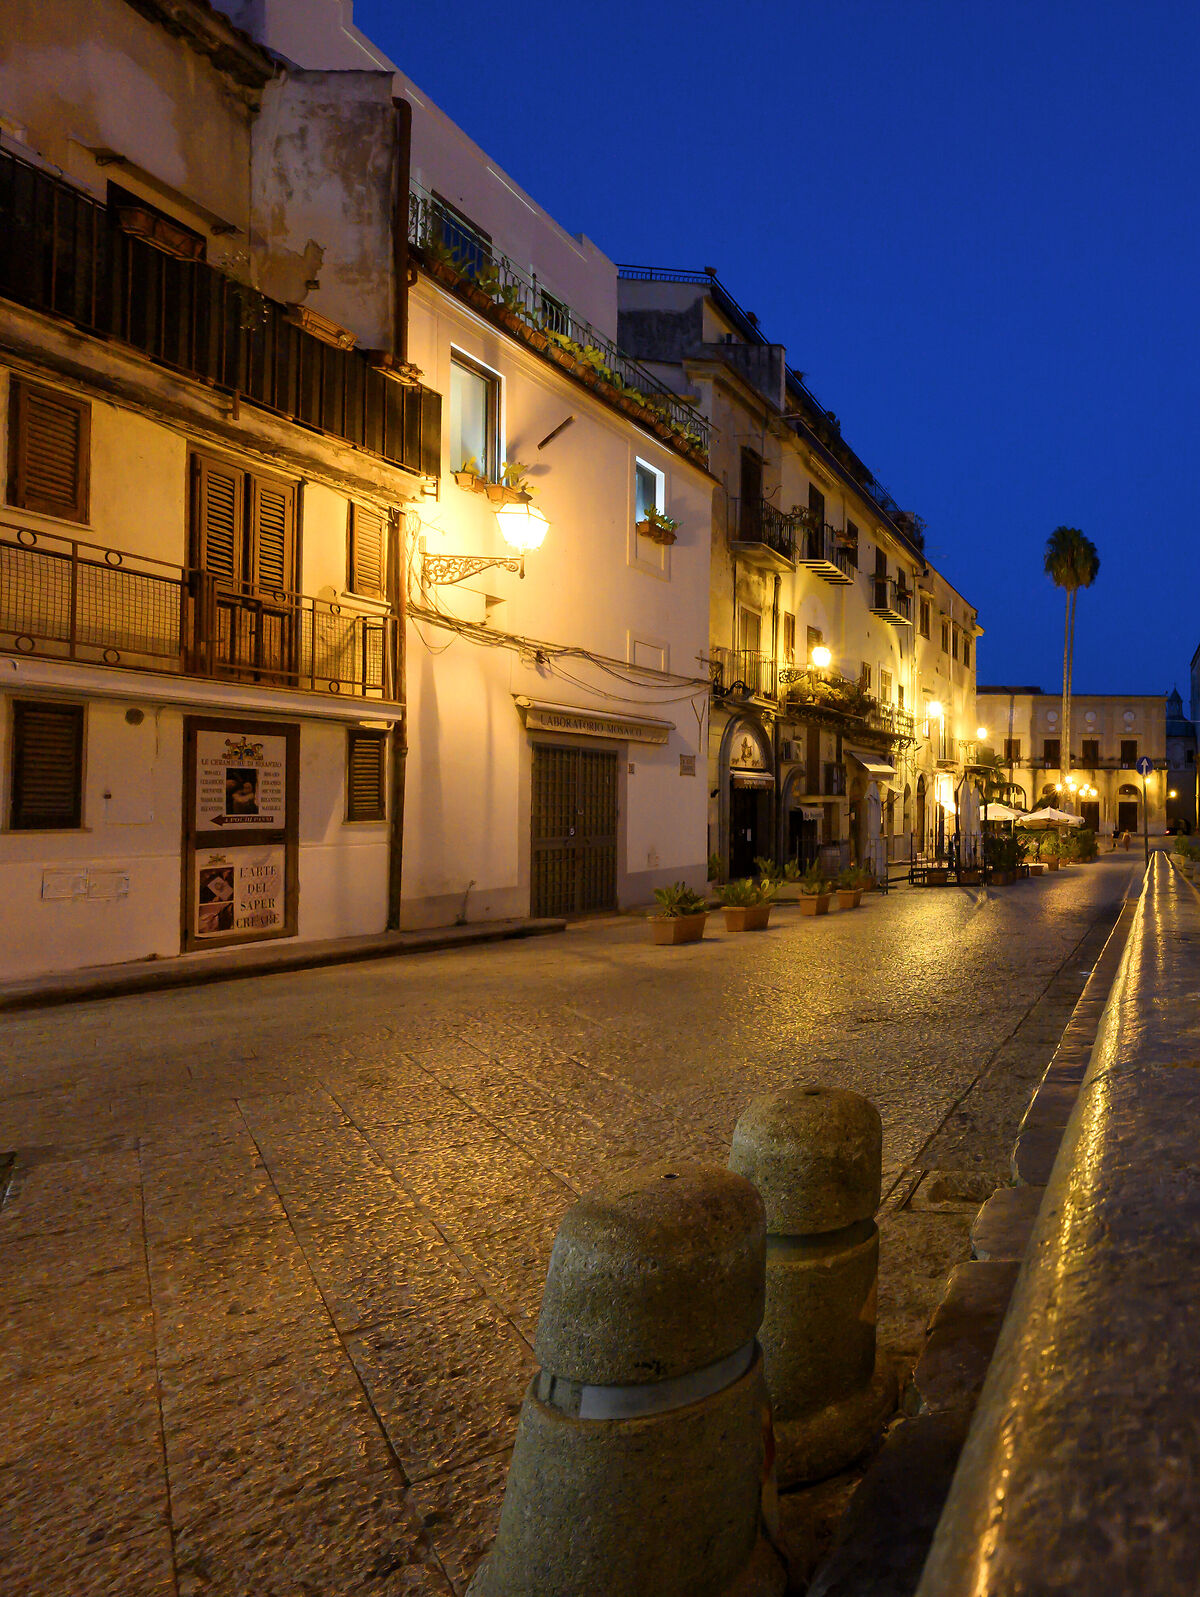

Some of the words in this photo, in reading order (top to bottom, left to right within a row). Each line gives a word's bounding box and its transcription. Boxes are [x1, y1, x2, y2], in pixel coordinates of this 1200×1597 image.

[540, 714, 604, 731] LABORATORIO
[607, 724, 642, 737] MOSAICO
[211, 759, 245, 767] CERAMICHE
[240, 866, 276, 878] L'ARTE
[247, 883, 269, 894] DEL
[240, 898, 275, 911] SAPER
[236, 913, 280, 928] CREARE
